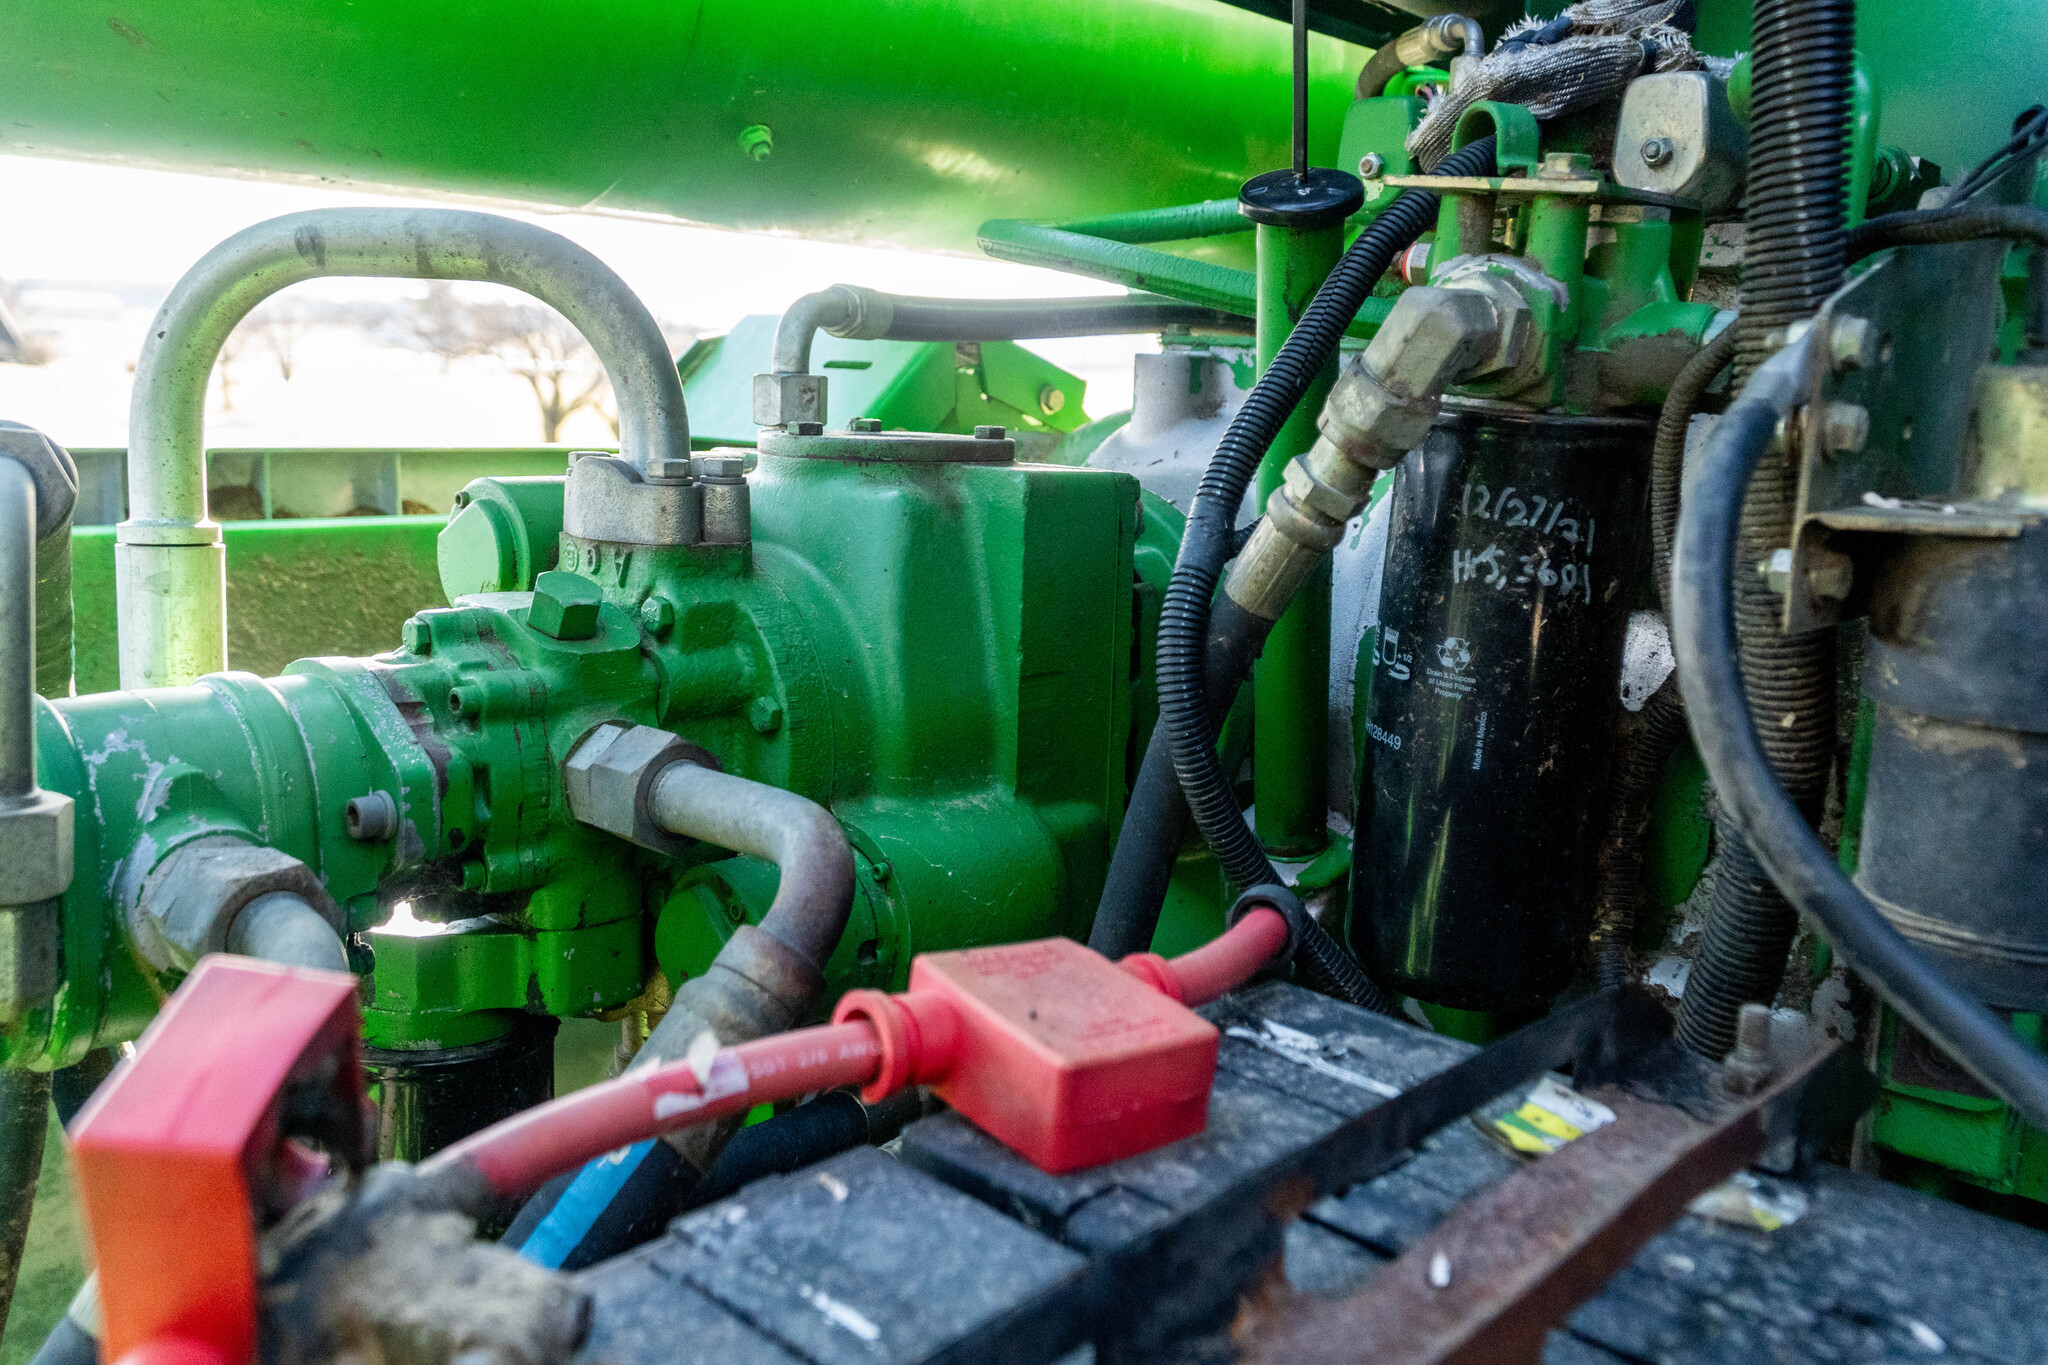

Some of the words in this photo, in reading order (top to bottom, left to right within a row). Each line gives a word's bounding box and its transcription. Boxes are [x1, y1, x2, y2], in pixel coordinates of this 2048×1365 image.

[1462, 483, 1596, 556] 12/27/21
[1426, 667, 1443, 678] Drain
[1436, 679, 1453, 690] Used
[1454, 682, 1472, 692] Filter
[1434, 688, 1463, 701] Properly
[1477, 712, 1488, 739] Mexico
[1475, 740, 1484, 748] in
[1472, 749, 1483, 770] Made
